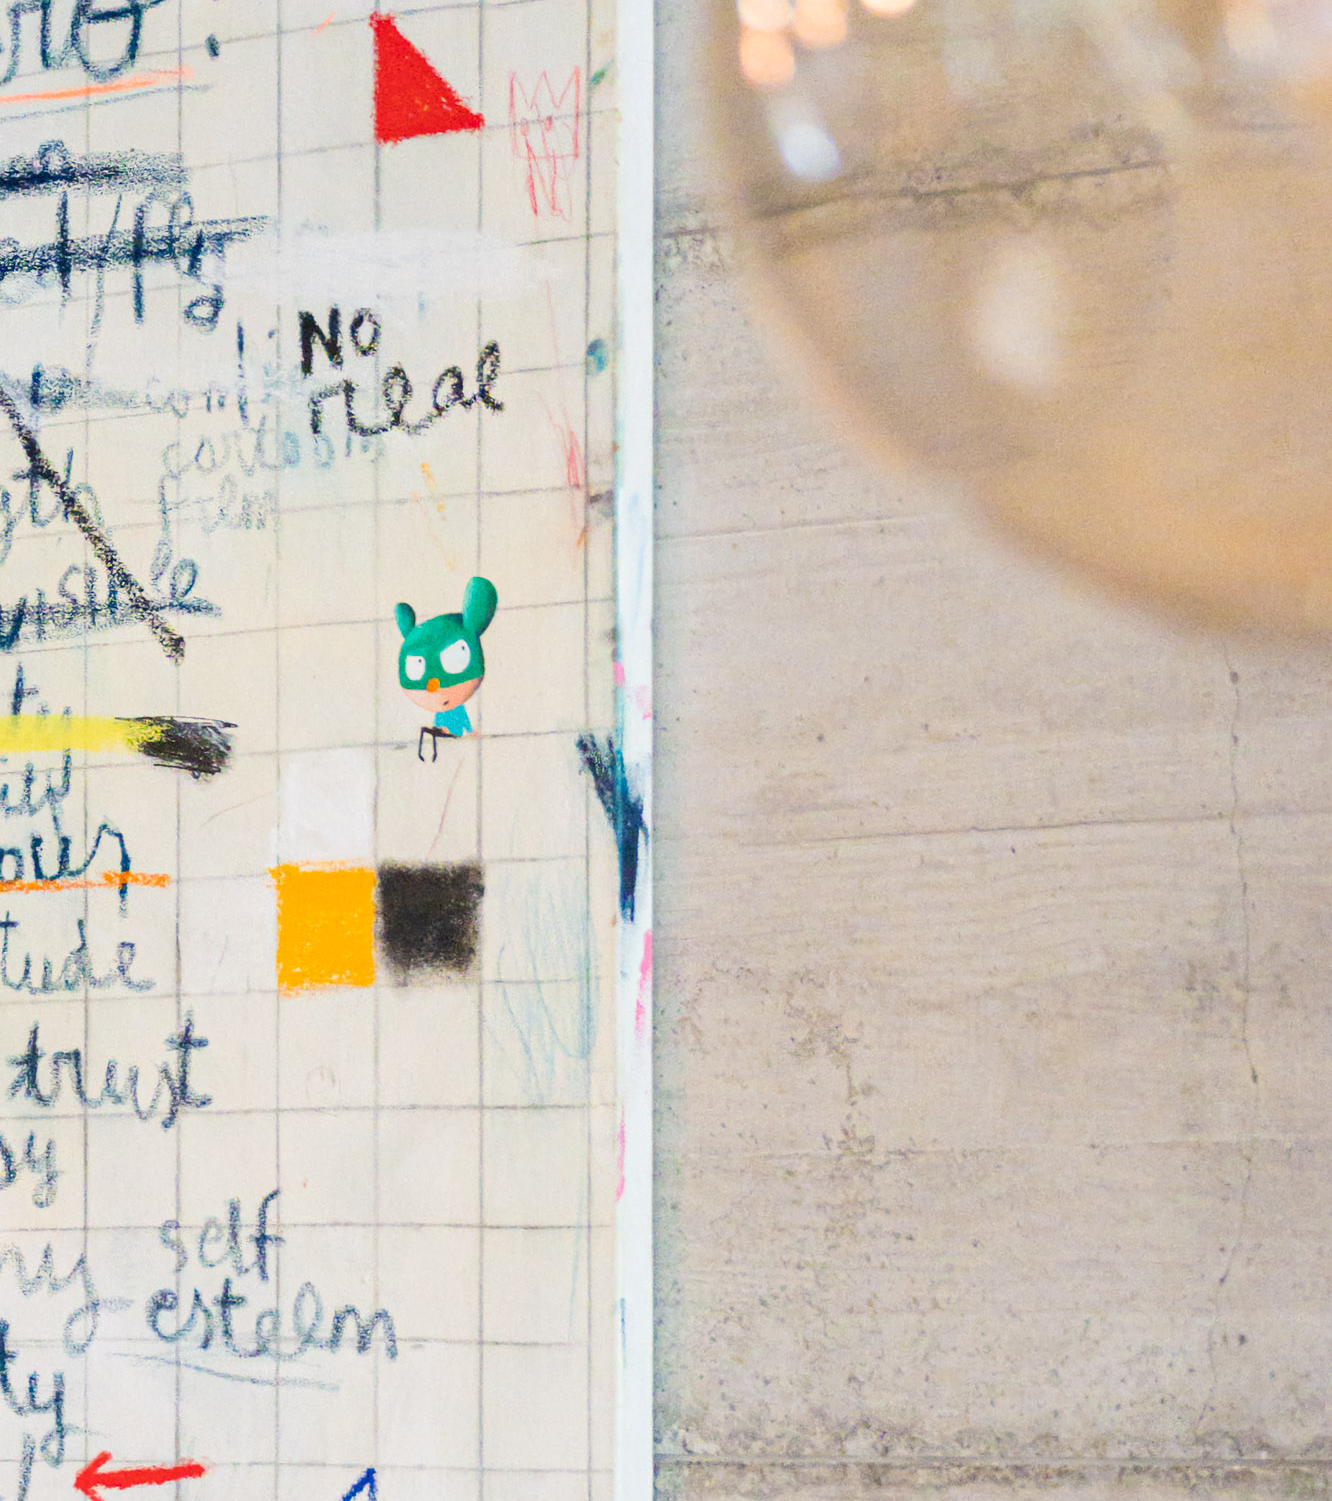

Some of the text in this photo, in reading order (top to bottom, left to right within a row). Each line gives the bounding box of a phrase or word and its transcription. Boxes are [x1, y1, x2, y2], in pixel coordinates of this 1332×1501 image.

[307, 338, 505, 438] real
[8, 1010, 213, 1131] trust
[158, 1189, 286, 1283] self
